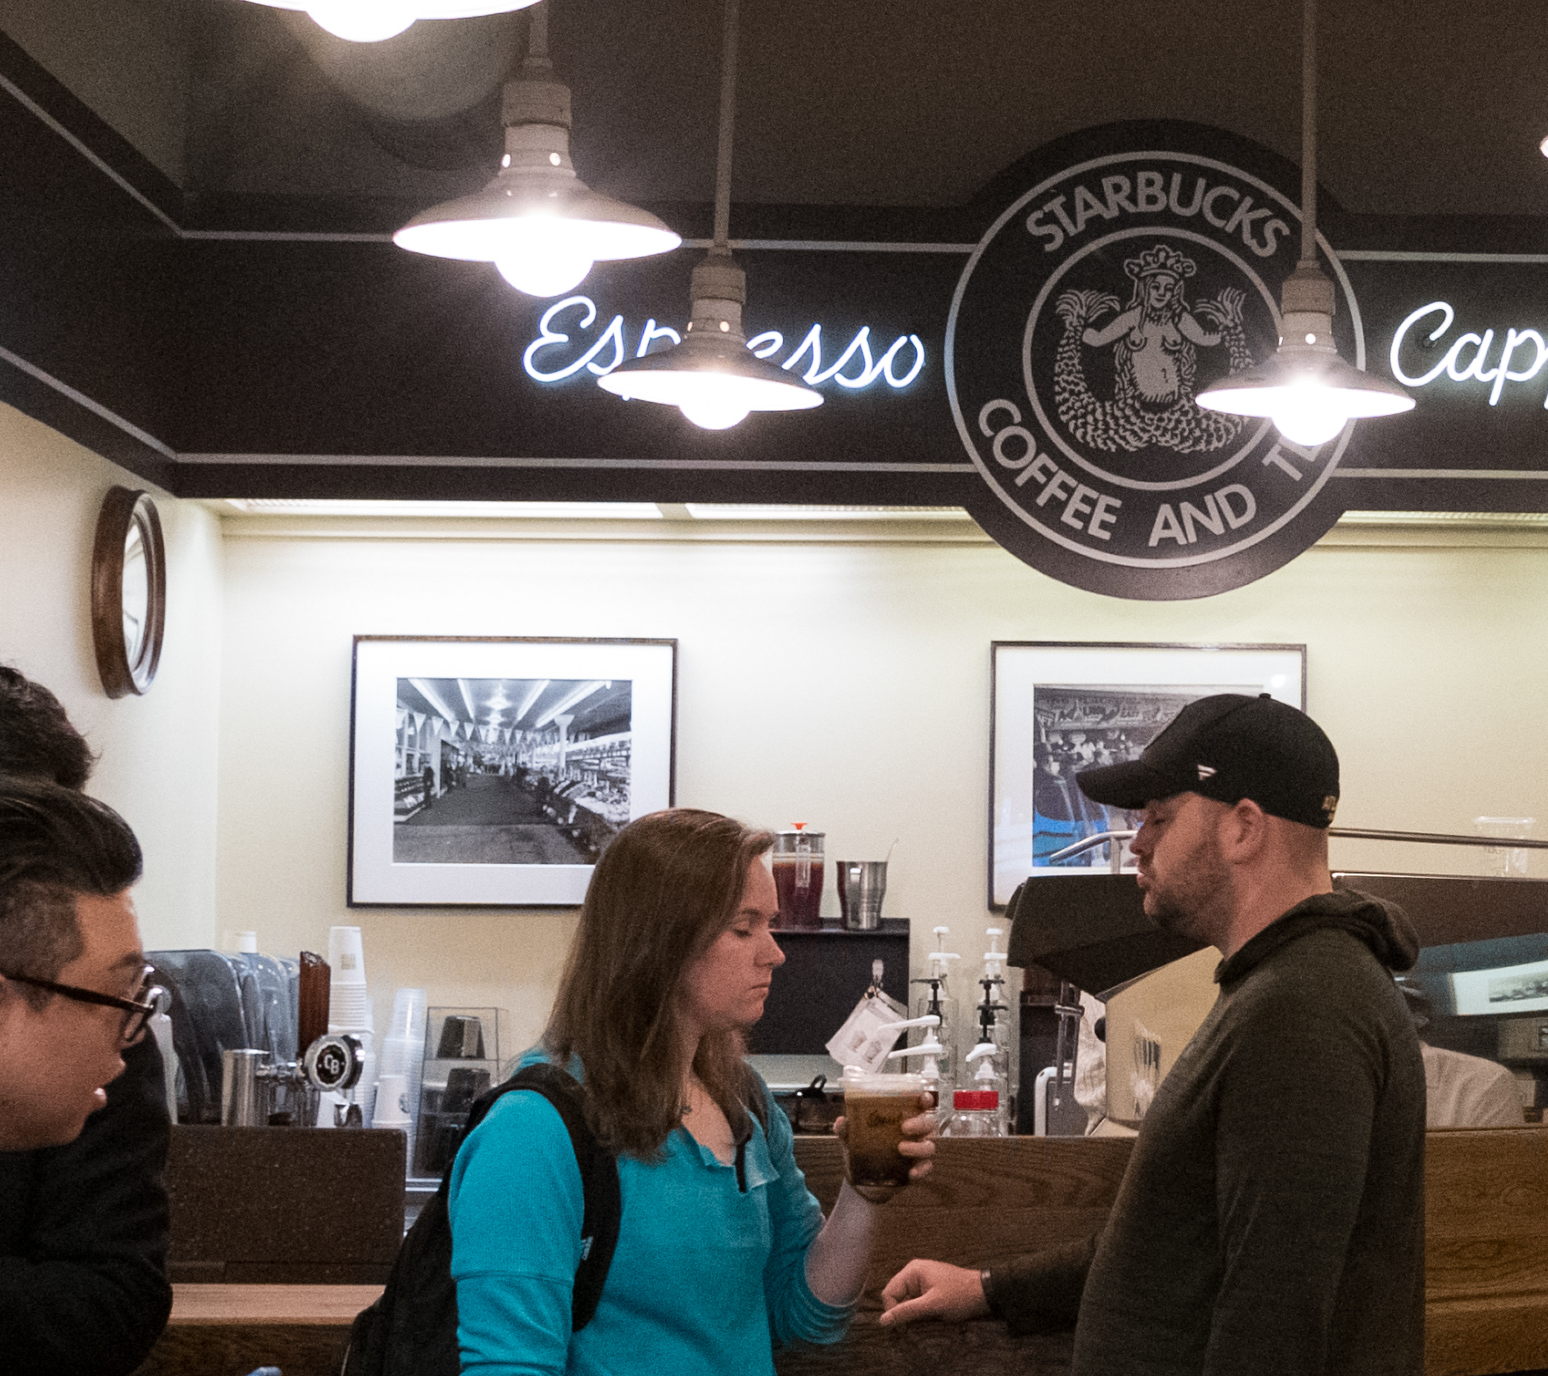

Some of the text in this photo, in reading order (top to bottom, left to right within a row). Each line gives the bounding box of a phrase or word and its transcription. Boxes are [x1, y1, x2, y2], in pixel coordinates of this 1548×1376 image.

[1025, 171, 1290, 258] STARBUCKS
[522, 295, 926, 400] Espesso
[977, 398, 1123, 542] COFFEE
[1148, 482, 1258, 547] AND
